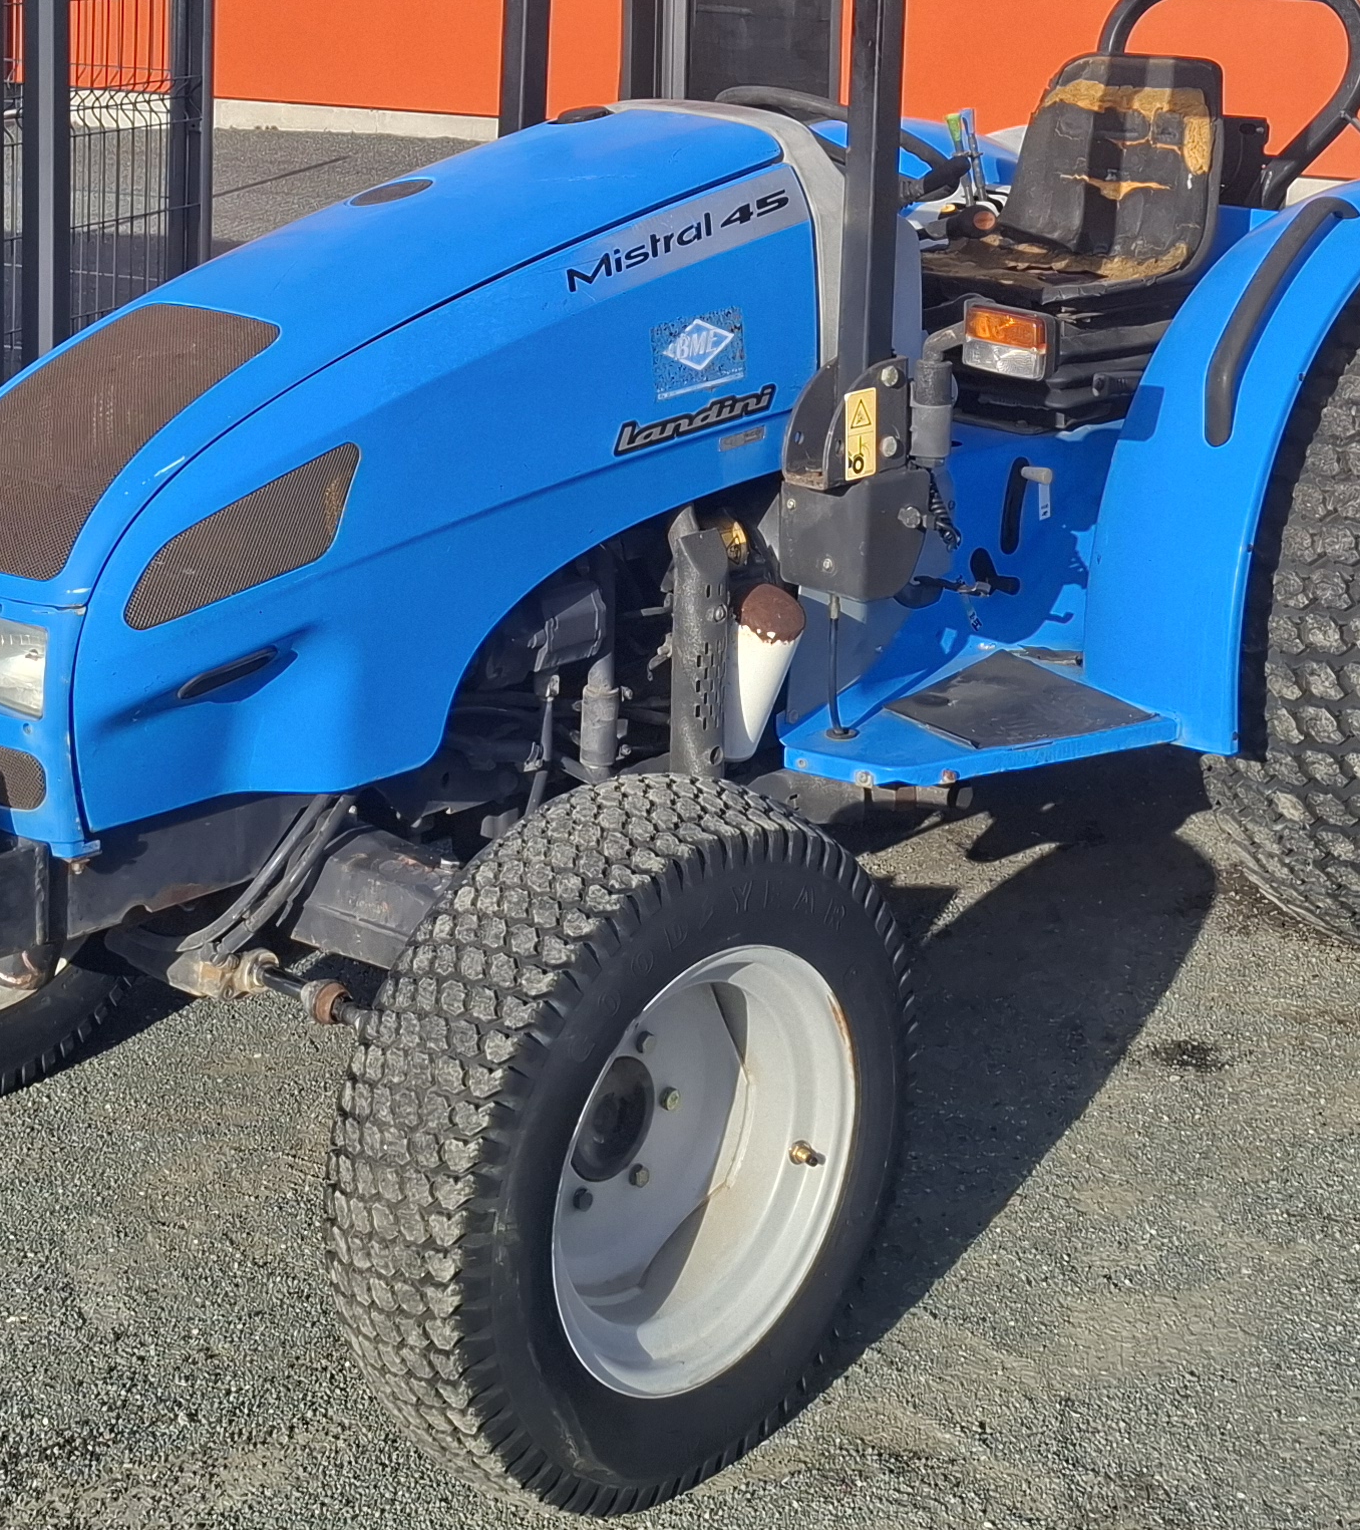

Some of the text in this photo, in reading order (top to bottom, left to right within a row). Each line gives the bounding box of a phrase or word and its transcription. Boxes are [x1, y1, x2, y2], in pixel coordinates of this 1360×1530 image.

[567, 188, 790, 292] Mistral 45
[615, 384, 775, 455] Landini
